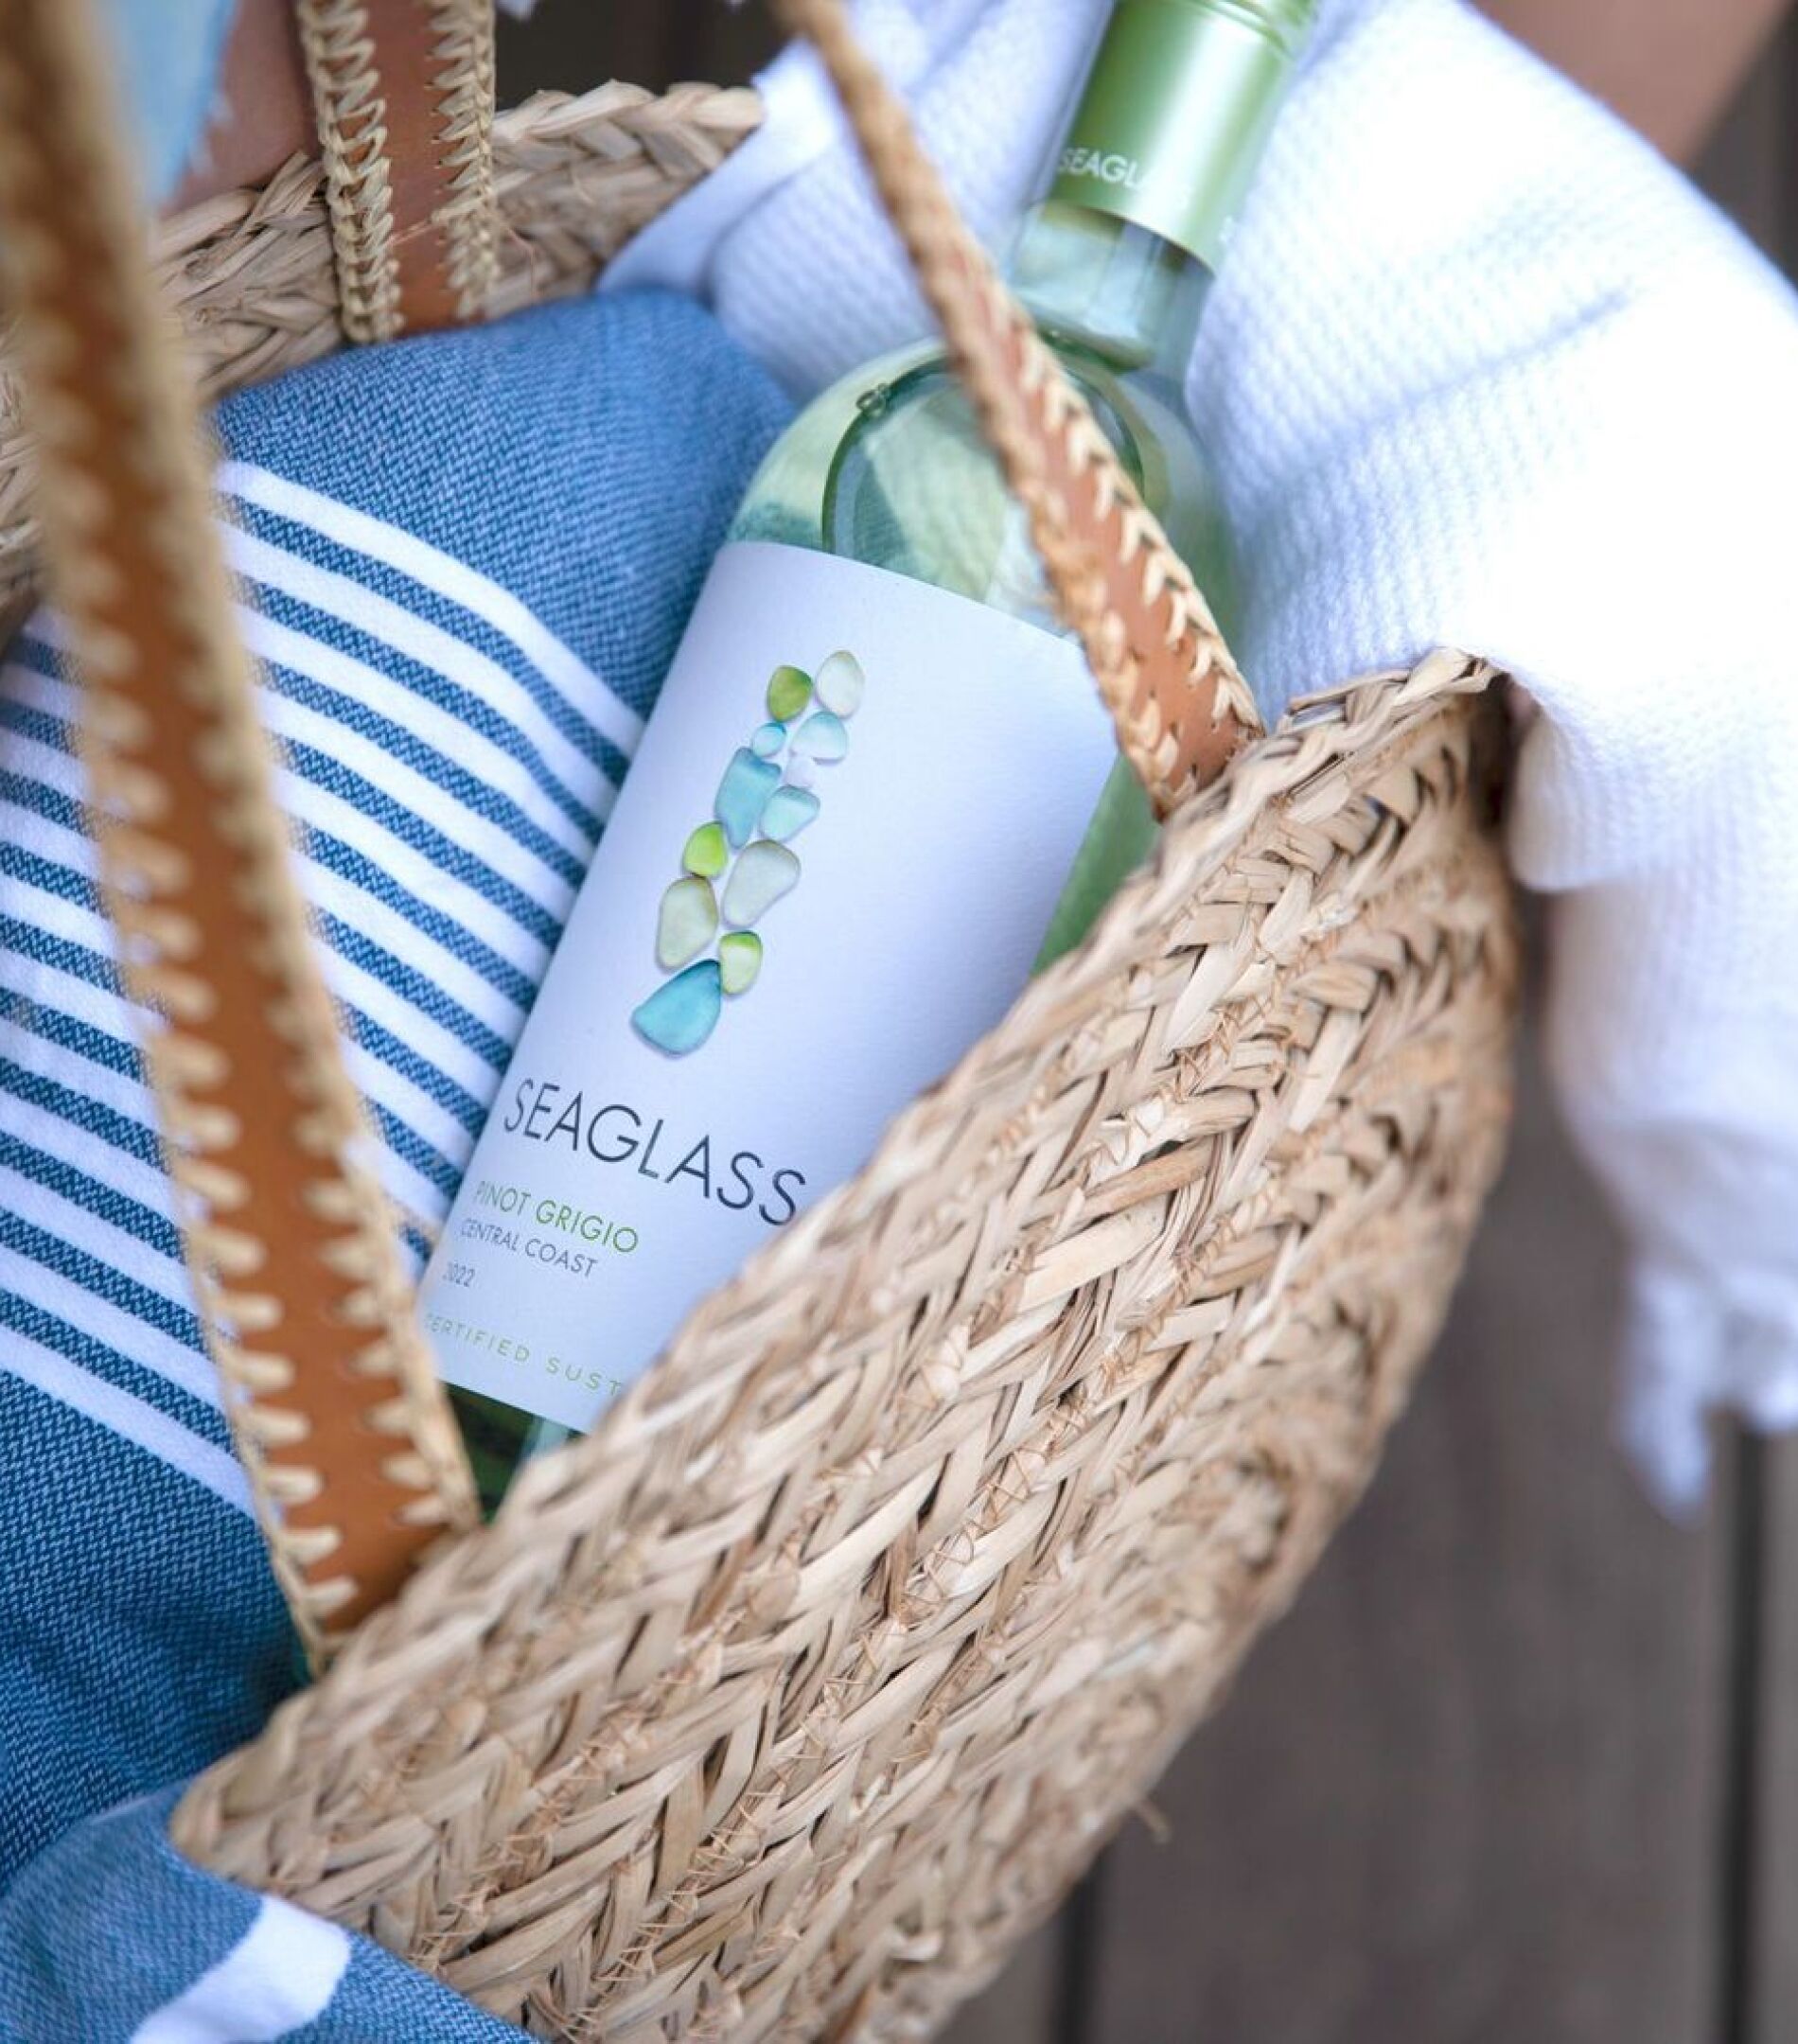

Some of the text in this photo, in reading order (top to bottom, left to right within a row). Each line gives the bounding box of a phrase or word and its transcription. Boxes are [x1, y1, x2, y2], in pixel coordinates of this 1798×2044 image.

[1057, 148, 1147, 191] SEAGL
[503, 1078, 806, 1227] SEAGLASS
[460, 1217, 599, 1278] CENTRAL COAST
[475, 1180, 640, 1254] PINOT GRIGIO
[545, 1357, 622, 1396] SUST
